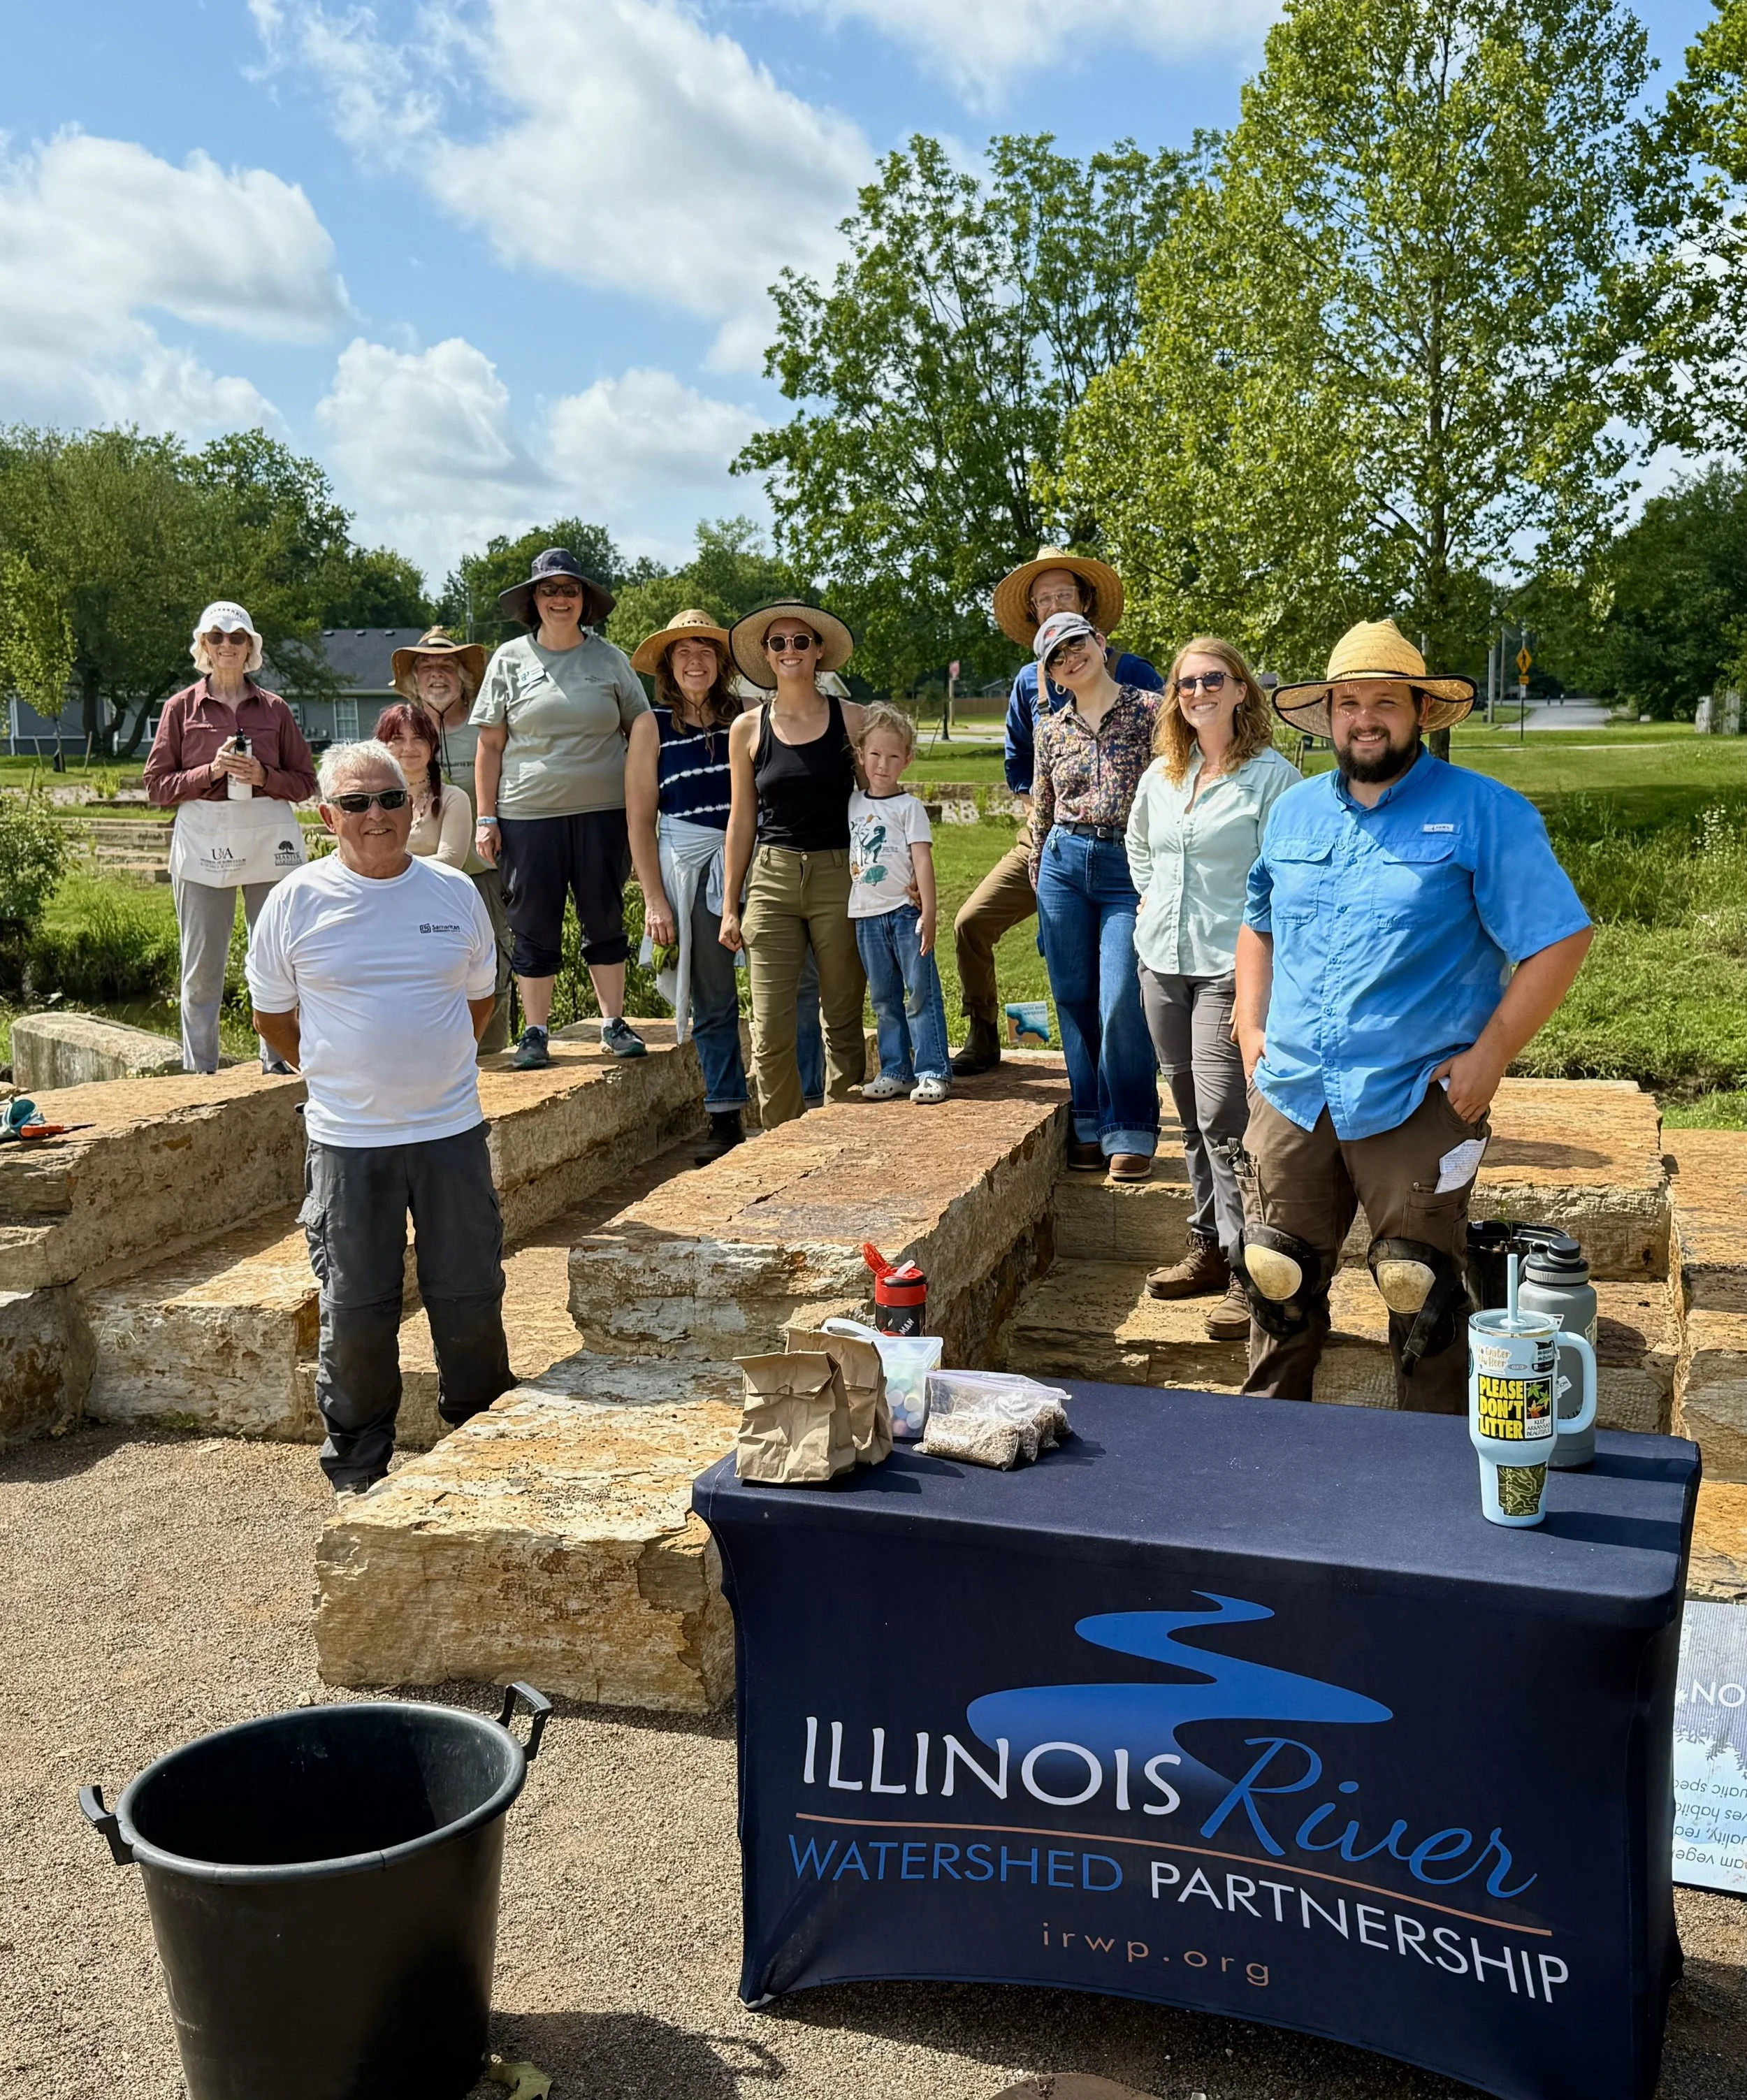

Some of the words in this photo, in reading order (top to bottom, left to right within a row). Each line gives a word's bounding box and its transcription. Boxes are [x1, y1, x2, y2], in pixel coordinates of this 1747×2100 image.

[1479, 1375, 1523, 1400] PLEASE
[1479, 1395, 1523, 1419] DON'T
[1479, 1414, 1523, 1439] LITTER
[803, 1716, 1181, 1816] ILLINOIS
[1200, 1737, 1537, 1898] River
[1673, 1847, 1713, 1864] vege
[788, 1834, 1122, 1891] WATERSHED
[1151, 1861, 1569, 2004] PARTNERSHIP
[1043, 1922, 1269, 1987] irwp.org
